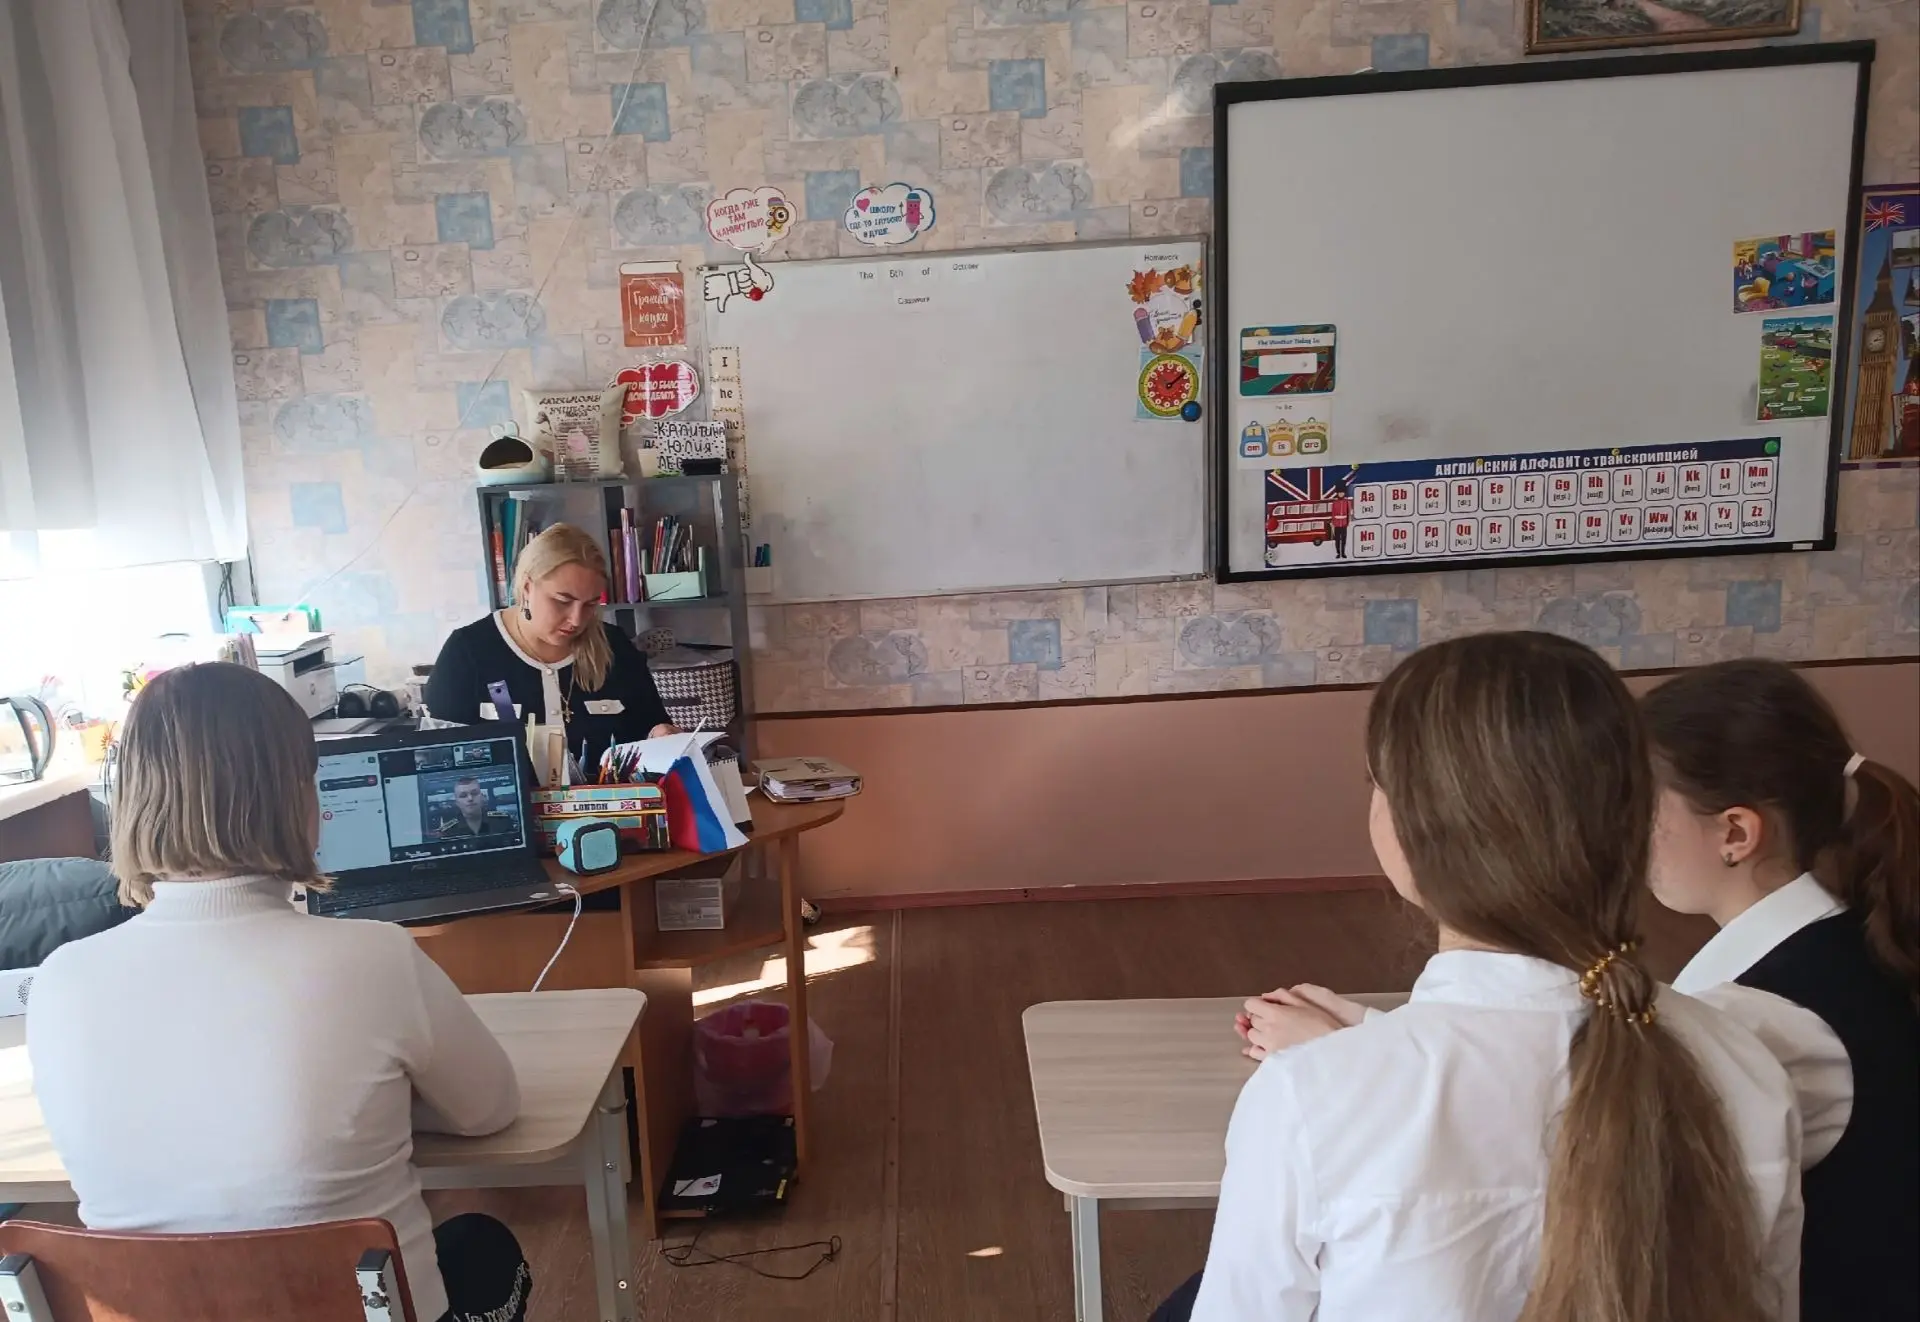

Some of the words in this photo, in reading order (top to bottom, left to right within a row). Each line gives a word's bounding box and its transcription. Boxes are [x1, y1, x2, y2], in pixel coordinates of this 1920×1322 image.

[714, 204, 740, 218] КОГДА
[741, 198, 760, 210] УЖЕ
[728, 212, 746, 224] ТАМ
[859, 271, 874, 280] The
[922, 267, 931, 276] of
[722, 356, 728, 367] I
[719, 388, 733, 399] he
[657, 421, 726, 437] КАЛИТИНА
[667, 440, 712, 454] ЮЛИЯ
[1278, 441, 1286, 450] is
[1304, 441, 1319, 449] are
[1435, 457, 1518, 476] АНГЛИЙСКИЙ
[1519, 454, 1581, 472] АЛФАВИТ
[1583, 457, 1591, 467] с
[1592, 447, 1698, 468] транскрипцией
[1360, 490, 1375, 502] Aa
[1392, 489, 1407, 500] Bb
[1425, 487, 1440, 499] Cc
[1457, 484, 1472, 496] Dd
[1490, 482, 1504, 494] Ee
[1524, 480, 1535, 492] Ff
[1555, 479, 1570, 491] Gg
[1588, 476, 1603, 488] Hh
[1686, 470, 1700, 482] Kk
[1748, 466, 1768, 477] Mm
[1360, 530, 1375, 542] Nn
[1392, 528, 1407, 540] Oo
[1424, 526, 1439, 538] Pp
[1489, 522, 1502, 534] Rr
[1521, 520, 1536, 532] Ss
[1586, 516, 1601, 527] Uu
[1619, 513, 1633, 525] Vv
[1649, 512, 1668, 524] Ww
[1684, 509, 1697, 521] Xx
[1718, 507, 1731, 520] Yy
[1751, 505, 1763, 517] Zz
[573, 803, 608, 811] LONDON
